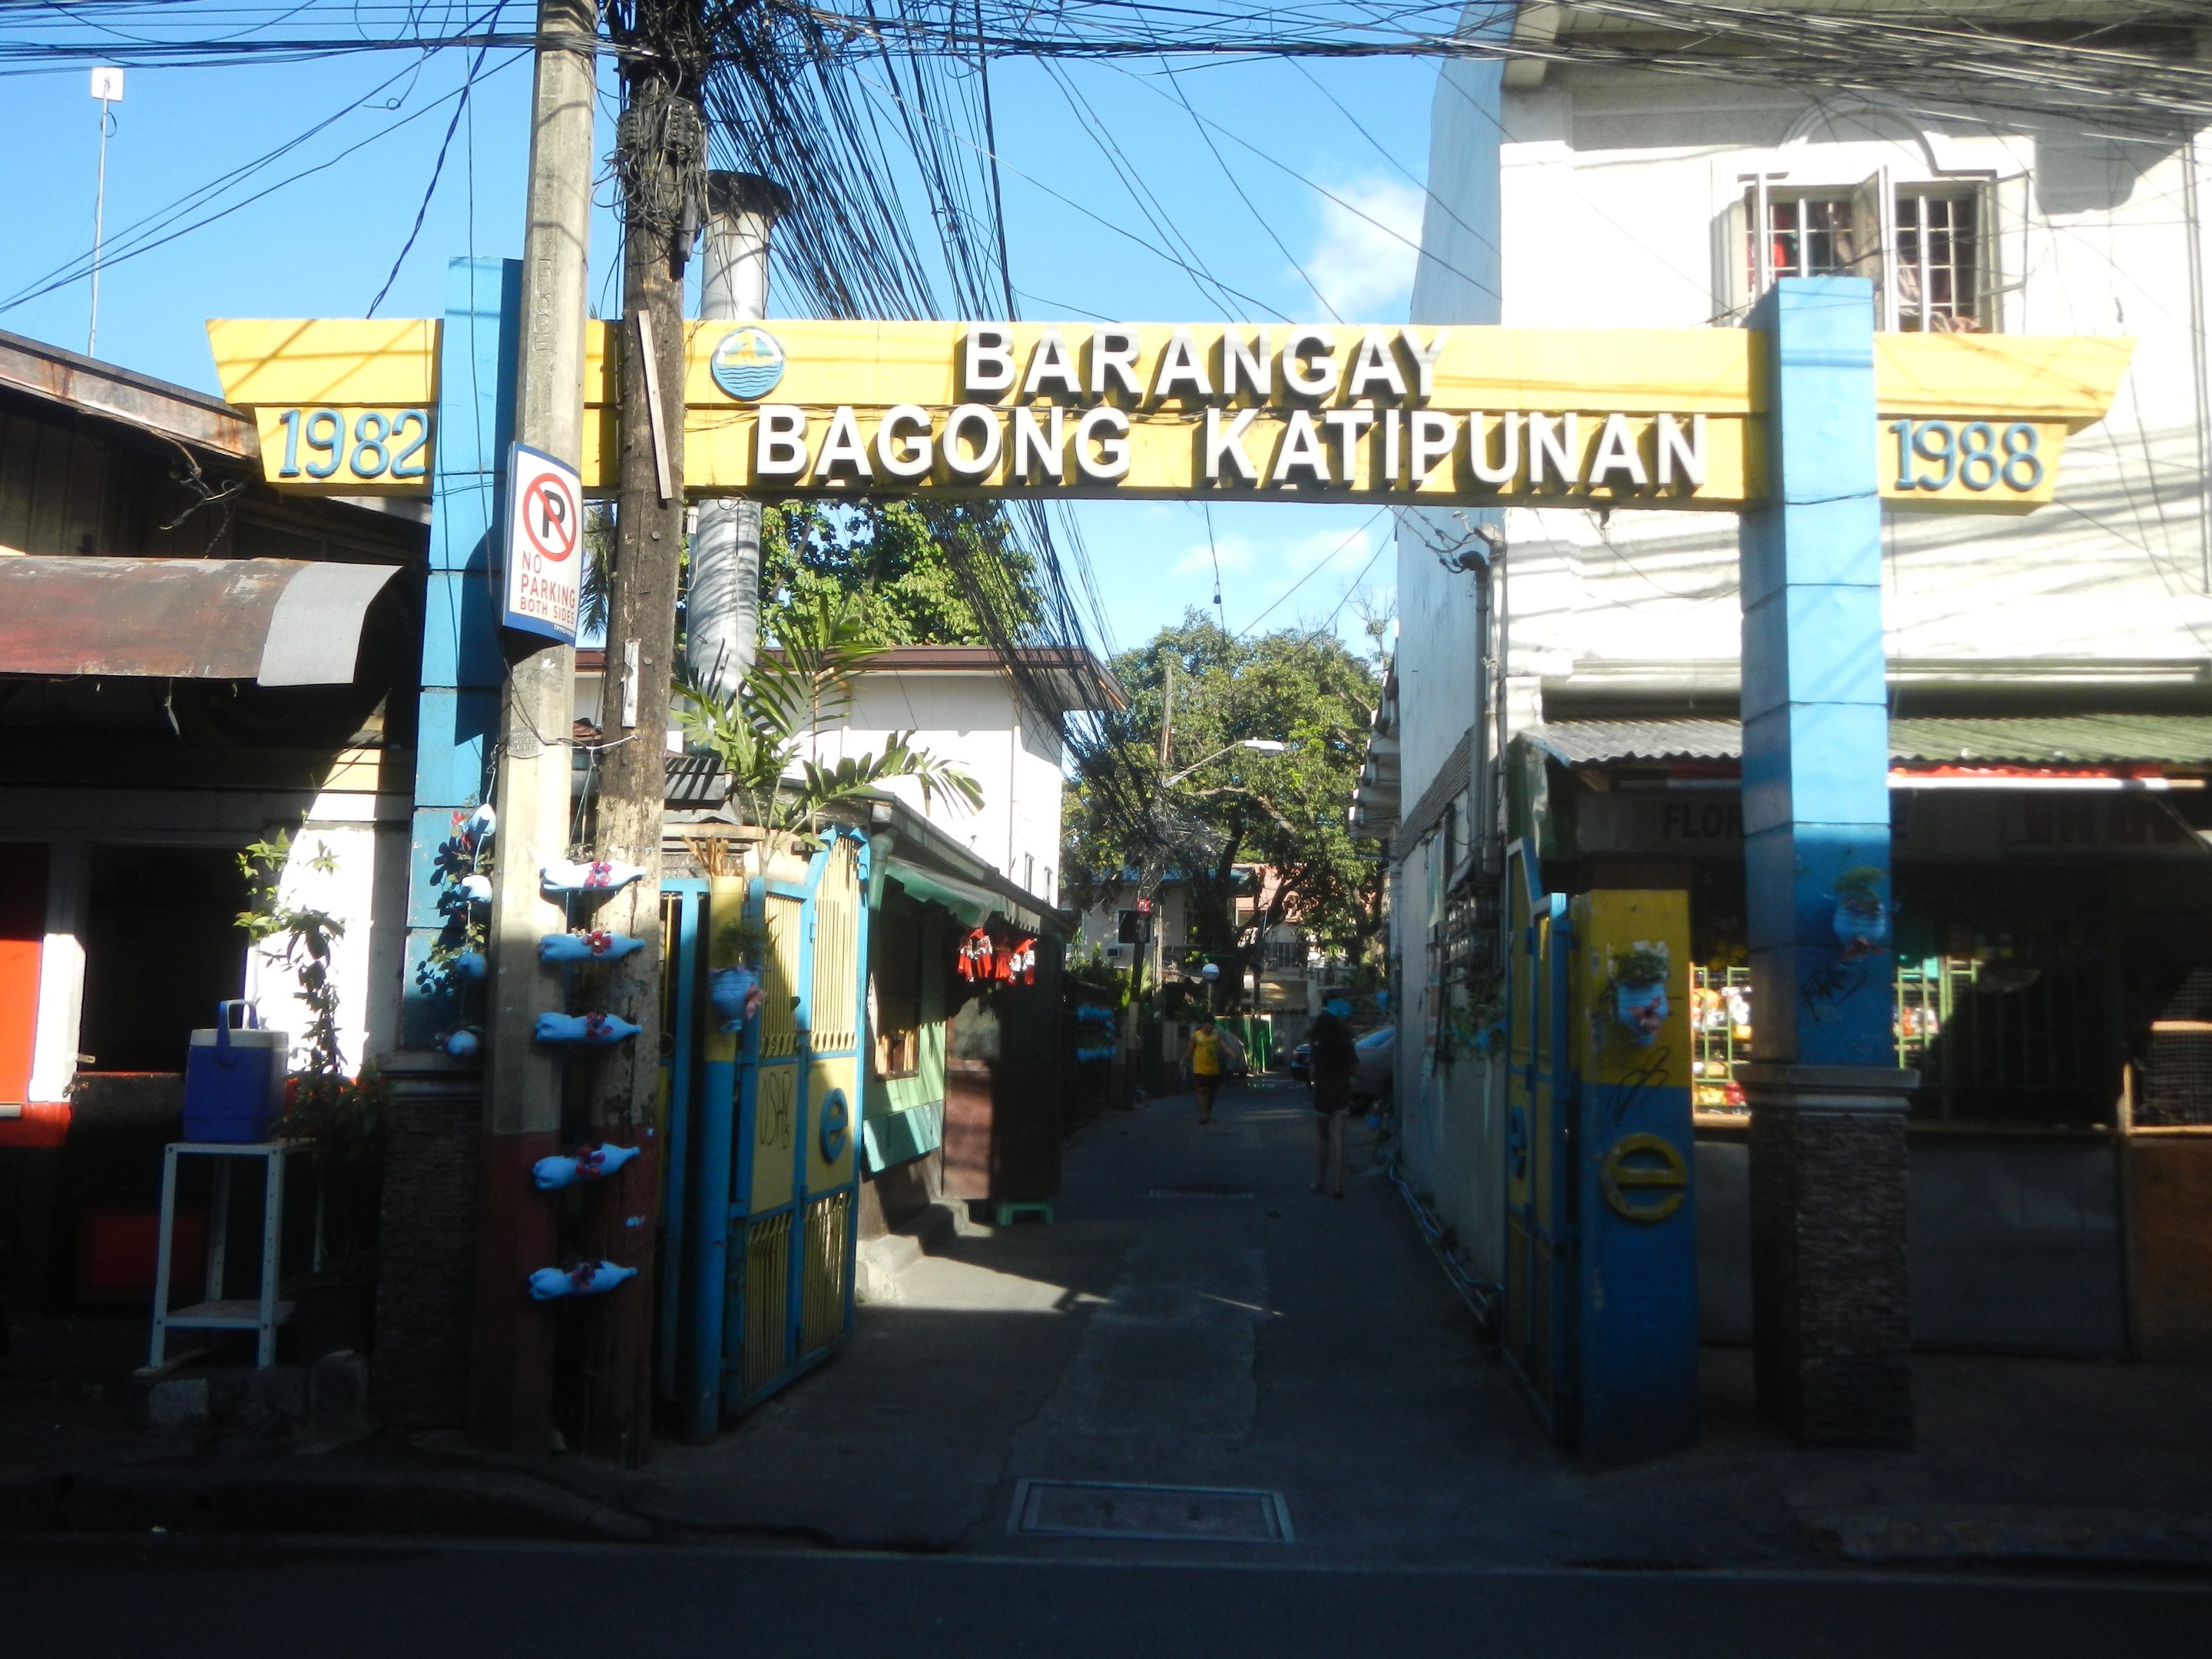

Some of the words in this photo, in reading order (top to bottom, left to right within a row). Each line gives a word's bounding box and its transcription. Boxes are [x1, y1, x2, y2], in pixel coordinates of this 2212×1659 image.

[964, 322, 1452, 399] BARANGAY
[278, 408, 431, 479] 1982
[756, 403, 1131, 480] BAGONG
[1205, 407, 1707, 485] KATIPUNAN
[1889, 419, 2043, 492] 1988
[521, 573, 575, 609] PARKING
[522, 550, 542, 575] NO
[520, 596, 548, 616] BOTH
[553, 605, 575, 625] SIDES
